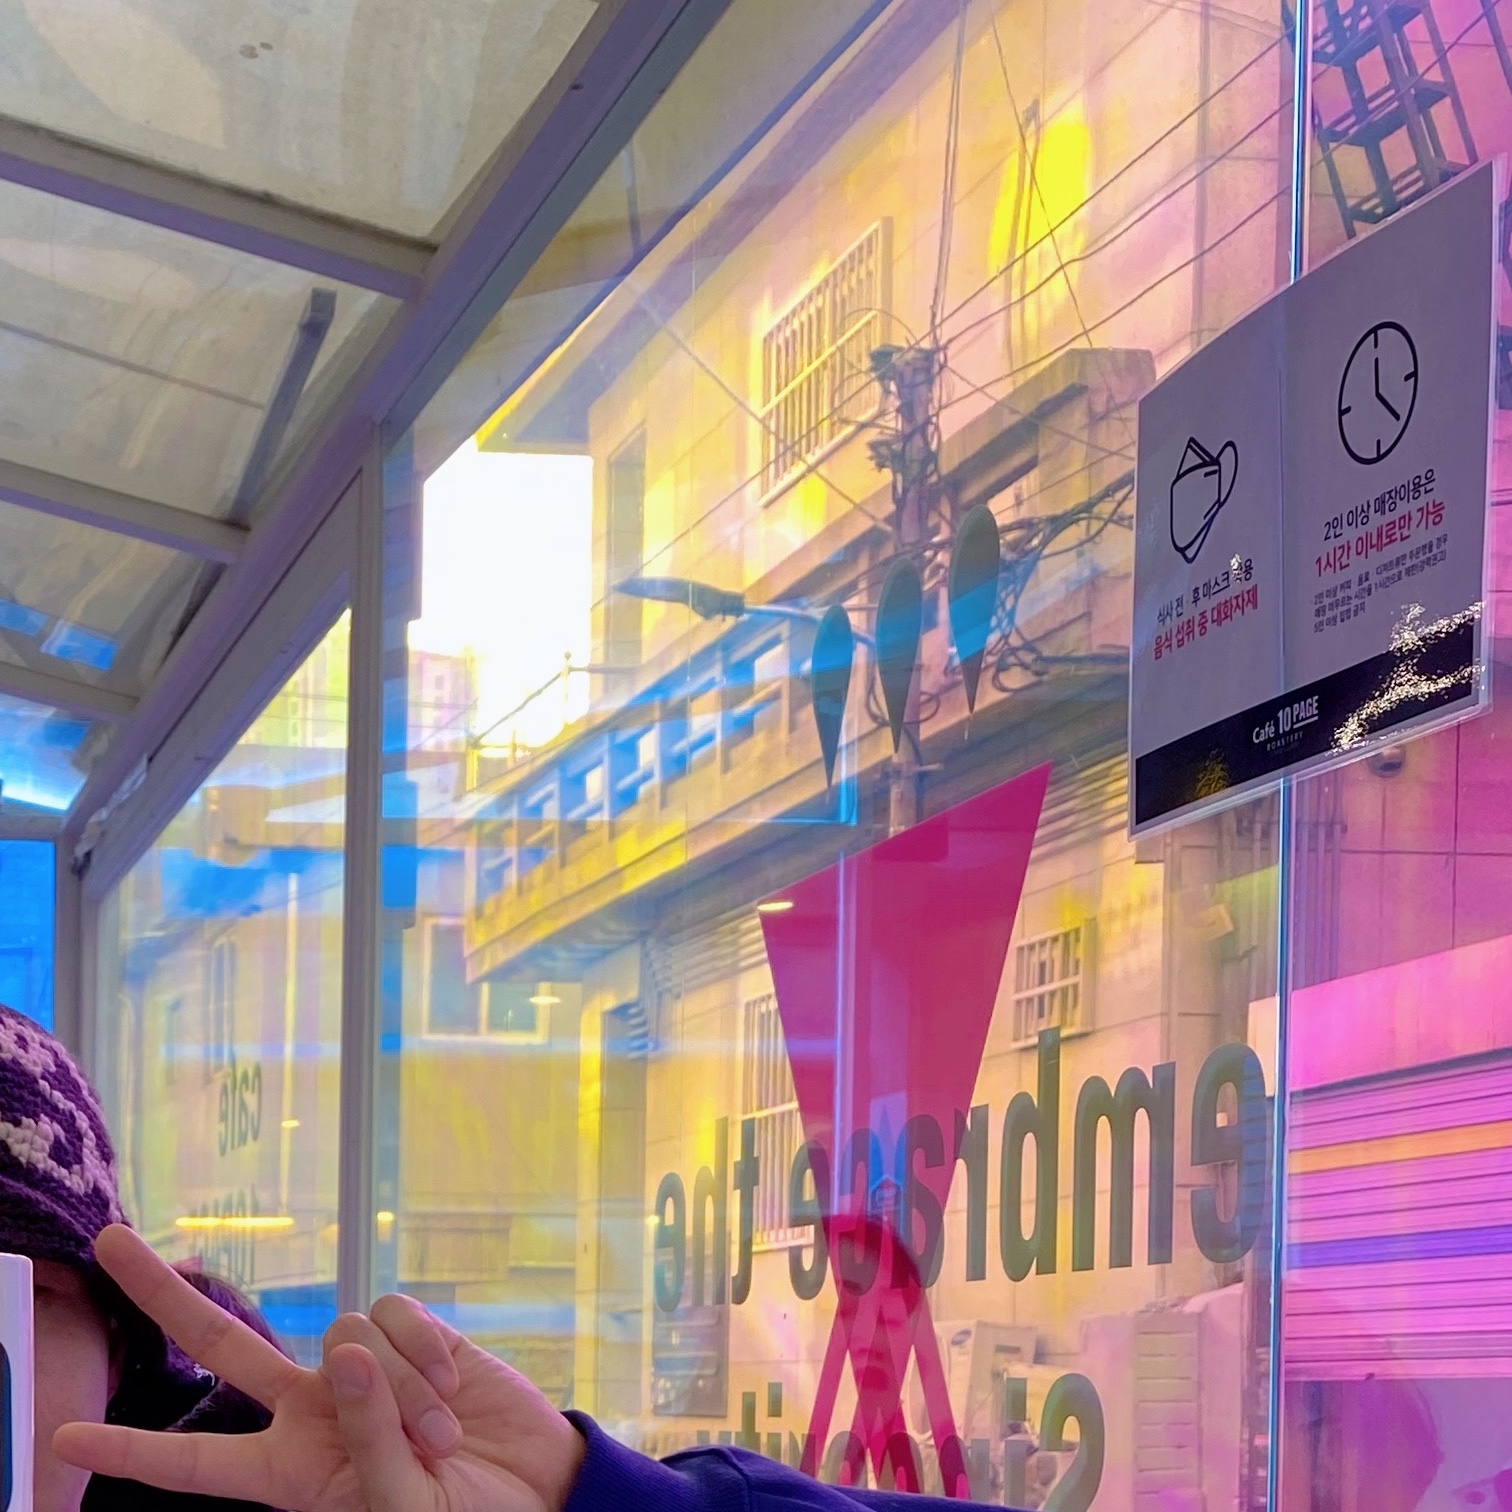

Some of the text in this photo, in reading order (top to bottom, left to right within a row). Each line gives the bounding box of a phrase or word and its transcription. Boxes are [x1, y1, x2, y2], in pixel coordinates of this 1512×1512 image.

[1315, 499, 1445, 578] 1시간 이내로만 가능
[1323, 468, 1436, 542] 2인 이상 매장이용은
[1154, 583, 1258, 661] 음식 섭취 중 대화자제
[1157, 600, 1173, 626] 식사
[1202, 570, 1231, 600] 마스크
[1252, 720, 1275, 743] Café
